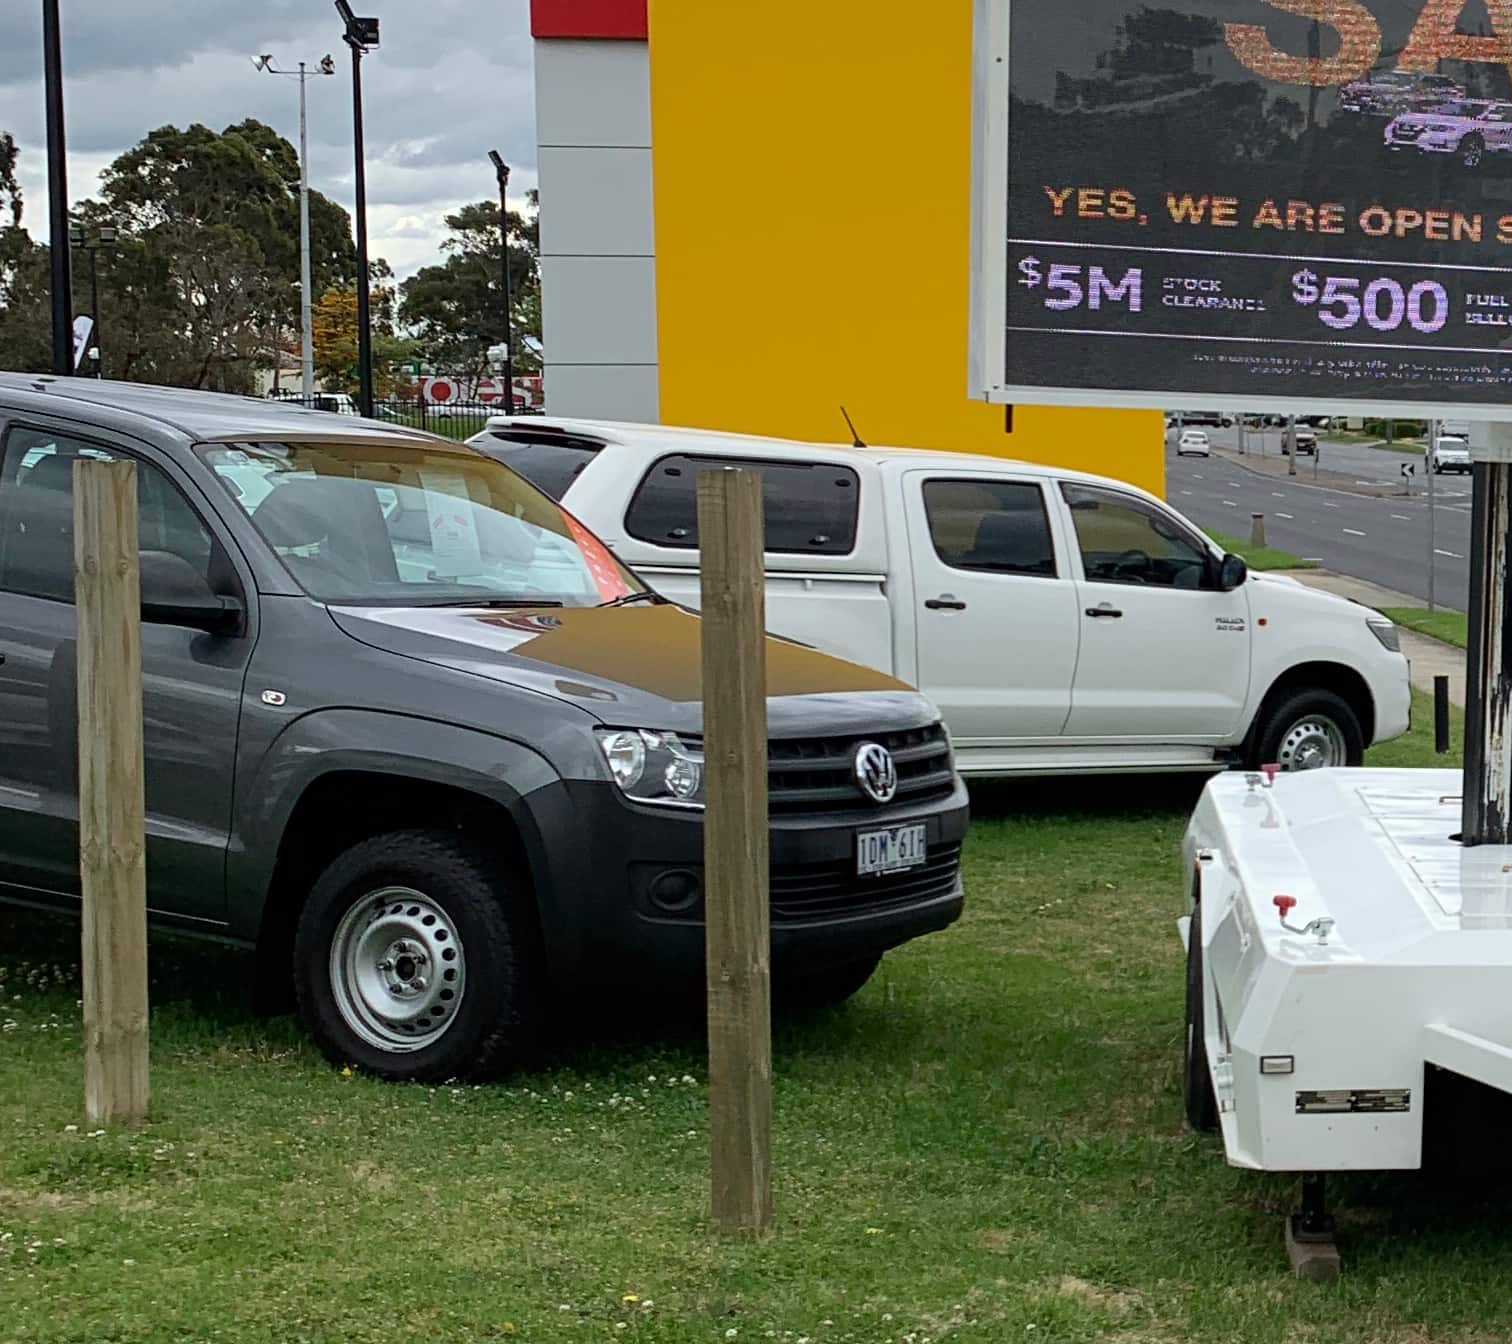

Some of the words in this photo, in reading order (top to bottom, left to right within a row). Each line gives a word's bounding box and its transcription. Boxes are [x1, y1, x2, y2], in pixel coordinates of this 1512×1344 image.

[1044, 185, 1148, 226] YES,
[1165, 191, 1239, 228] WE
[1253, 196, 1345, 234] ARE
[1359, 204, 1483, 243] OPEN
[1018, 255, 1142, 312] $5M
[1162, 277, 1222, 292] STOCK
[1291, 267, 1449, 334] $500
